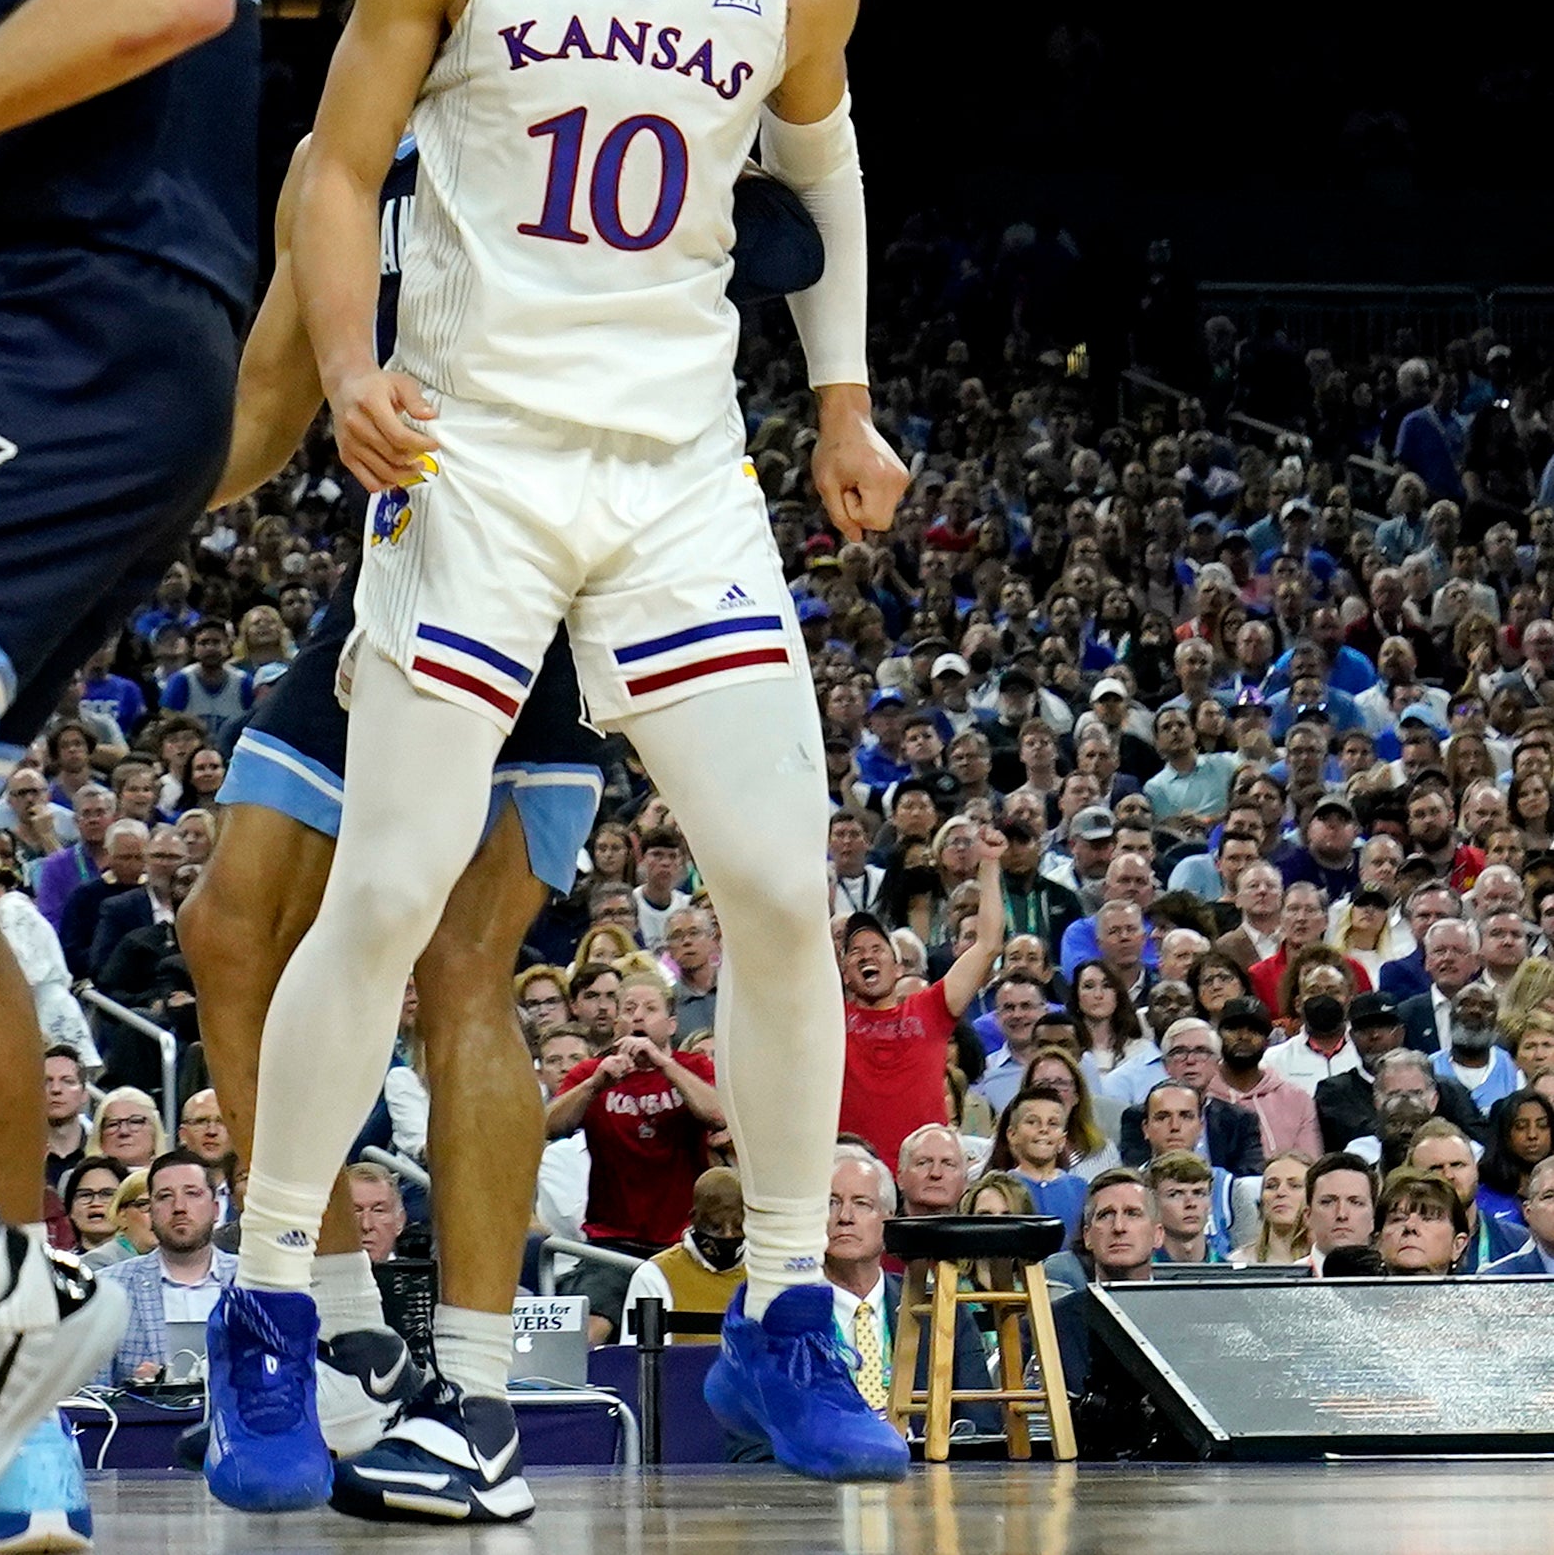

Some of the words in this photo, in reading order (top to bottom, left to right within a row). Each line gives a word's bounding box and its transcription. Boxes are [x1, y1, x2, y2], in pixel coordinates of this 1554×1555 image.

[498, 14, 754, 100] KANSAS
[516, 105, 689, 252] 10
[513, 1316, 564, 1331] VERS
[535, 1302, 546, 1315] is
[549, 1302, 571, 1316] for
